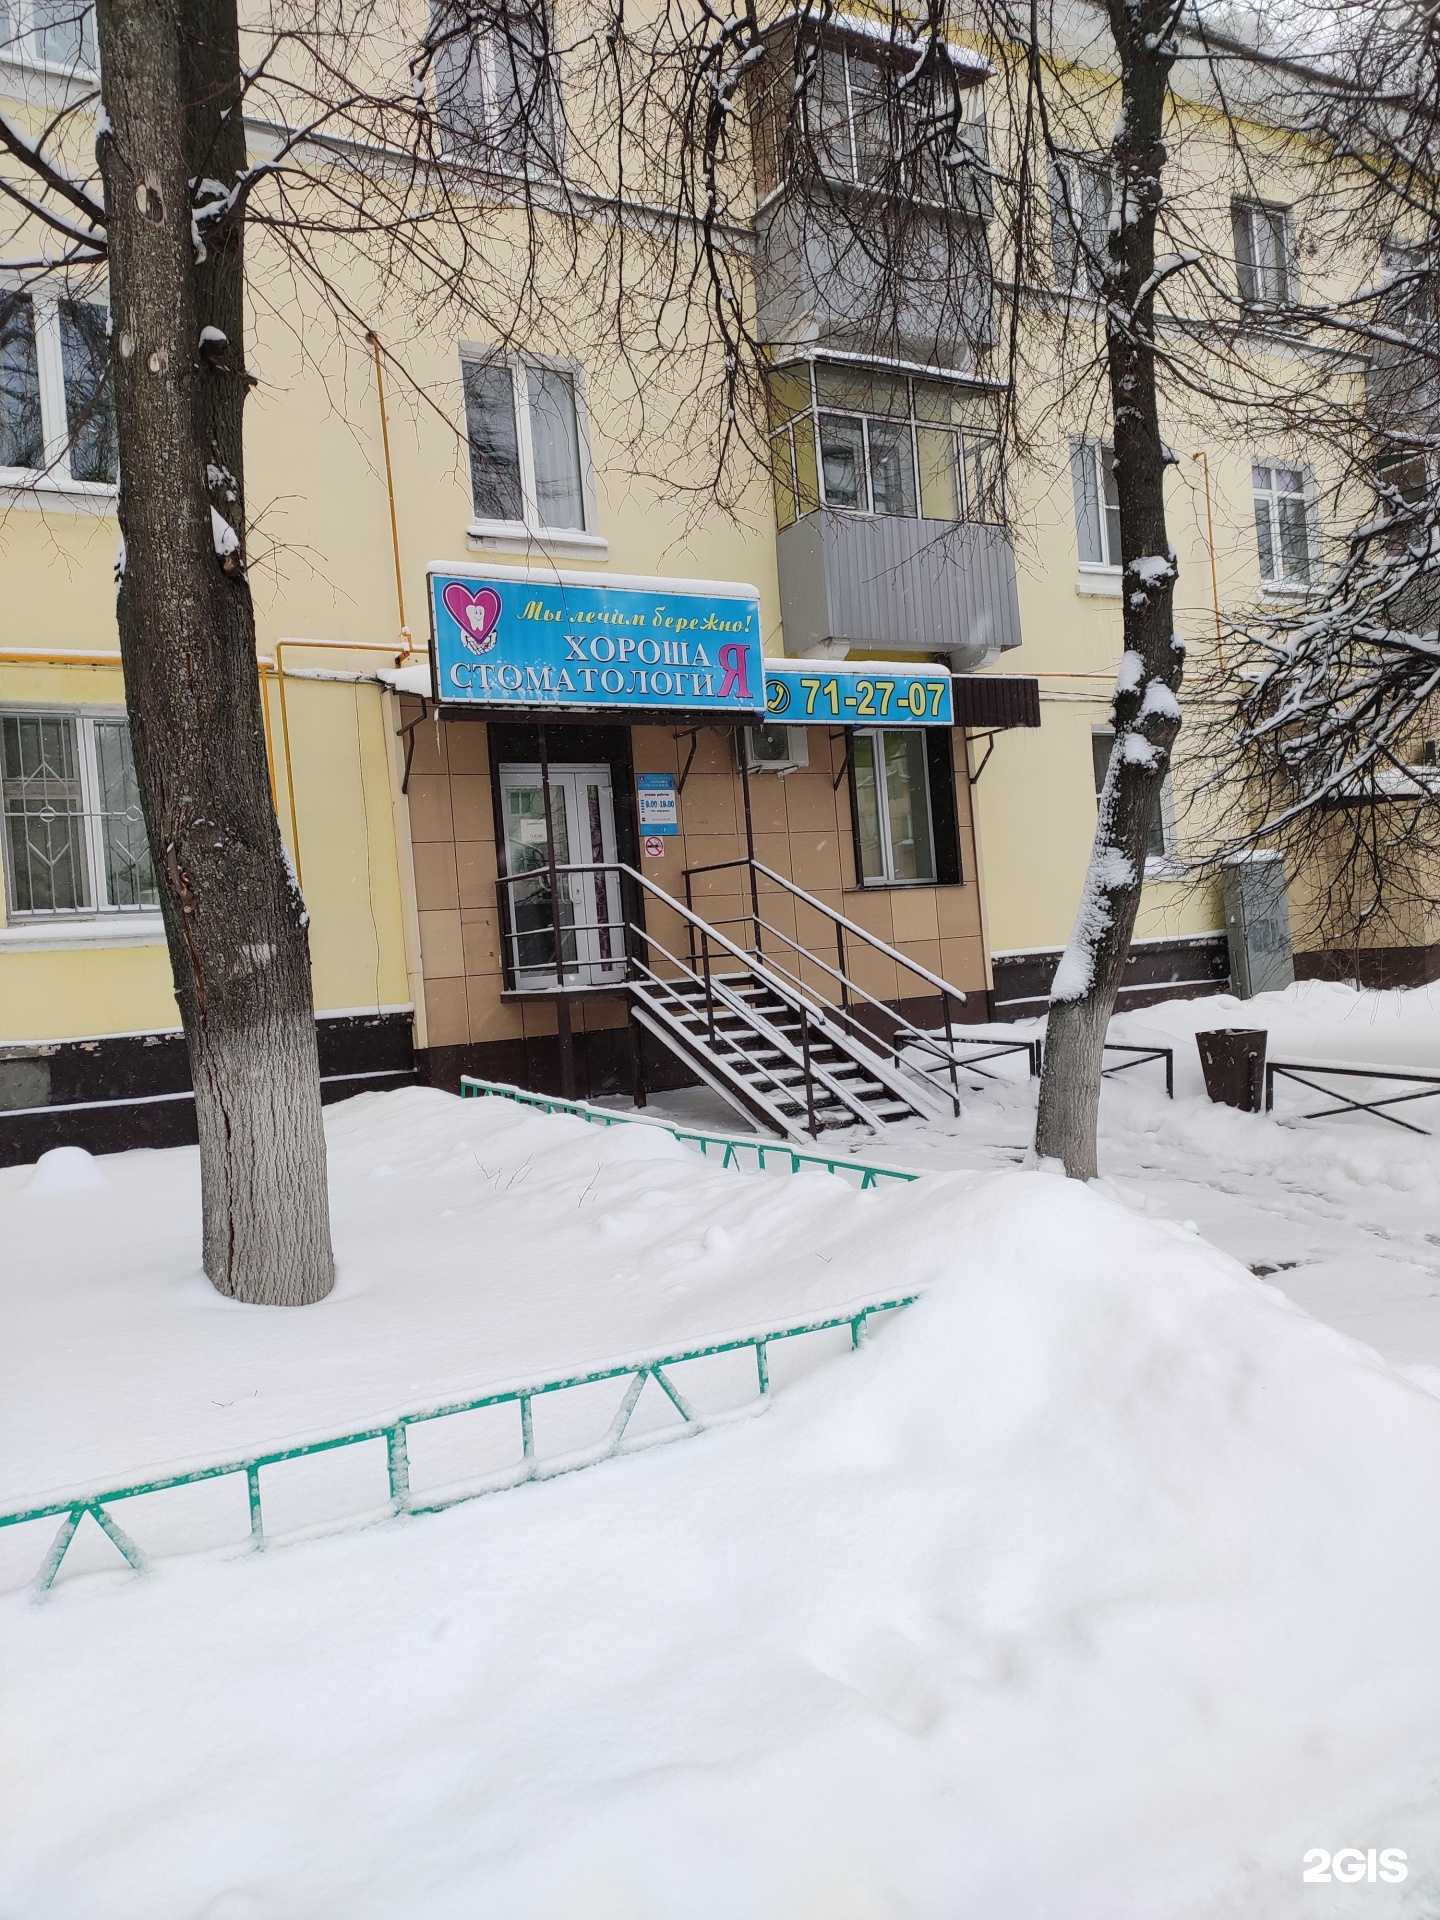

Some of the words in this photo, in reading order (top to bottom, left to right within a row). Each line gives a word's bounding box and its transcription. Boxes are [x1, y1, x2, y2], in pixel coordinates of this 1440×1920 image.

[517, 600, 563, 622] Мы
[569, 607, 646, 625] лечим
[652, 606, 752, 633] бережно!
[800, 679, 945, 717] 71-27-07
